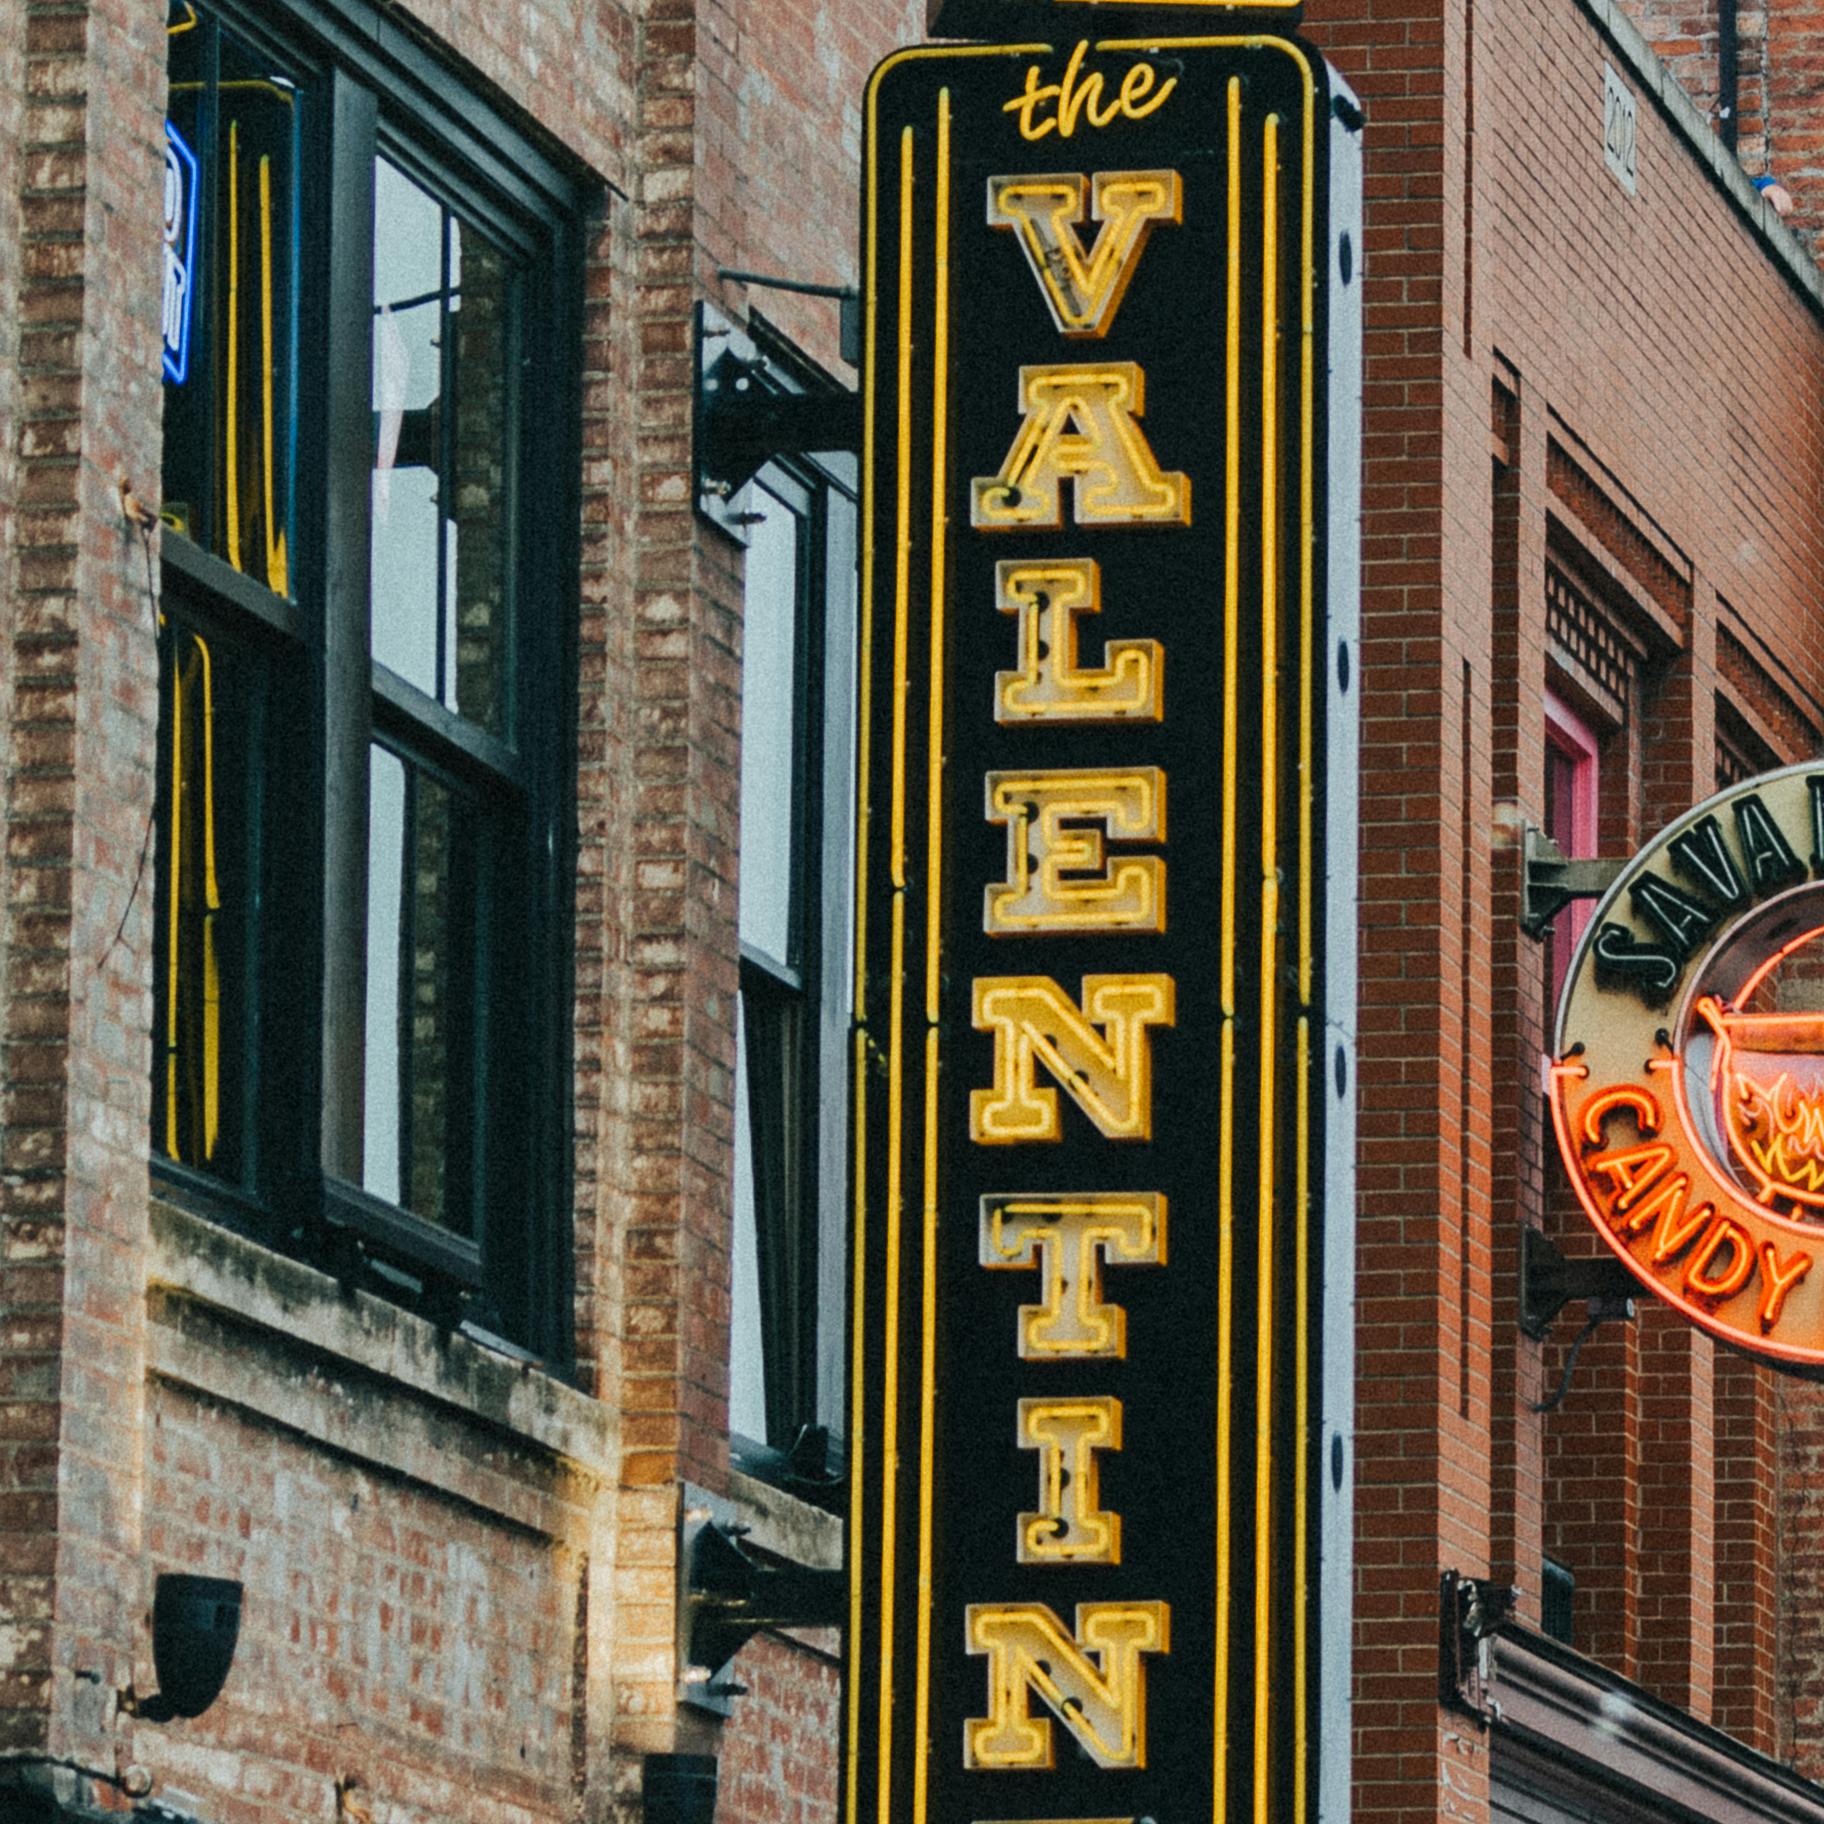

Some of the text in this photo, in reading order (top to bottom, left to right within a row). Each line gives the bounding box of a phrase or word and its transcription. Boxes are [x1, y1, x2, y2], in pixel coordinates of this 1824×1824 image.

[1003, 40, 1178, 141] the
[1606, 85, 1634, 177] 2012
[1581, 1084, 1811, 1335] CANDY
